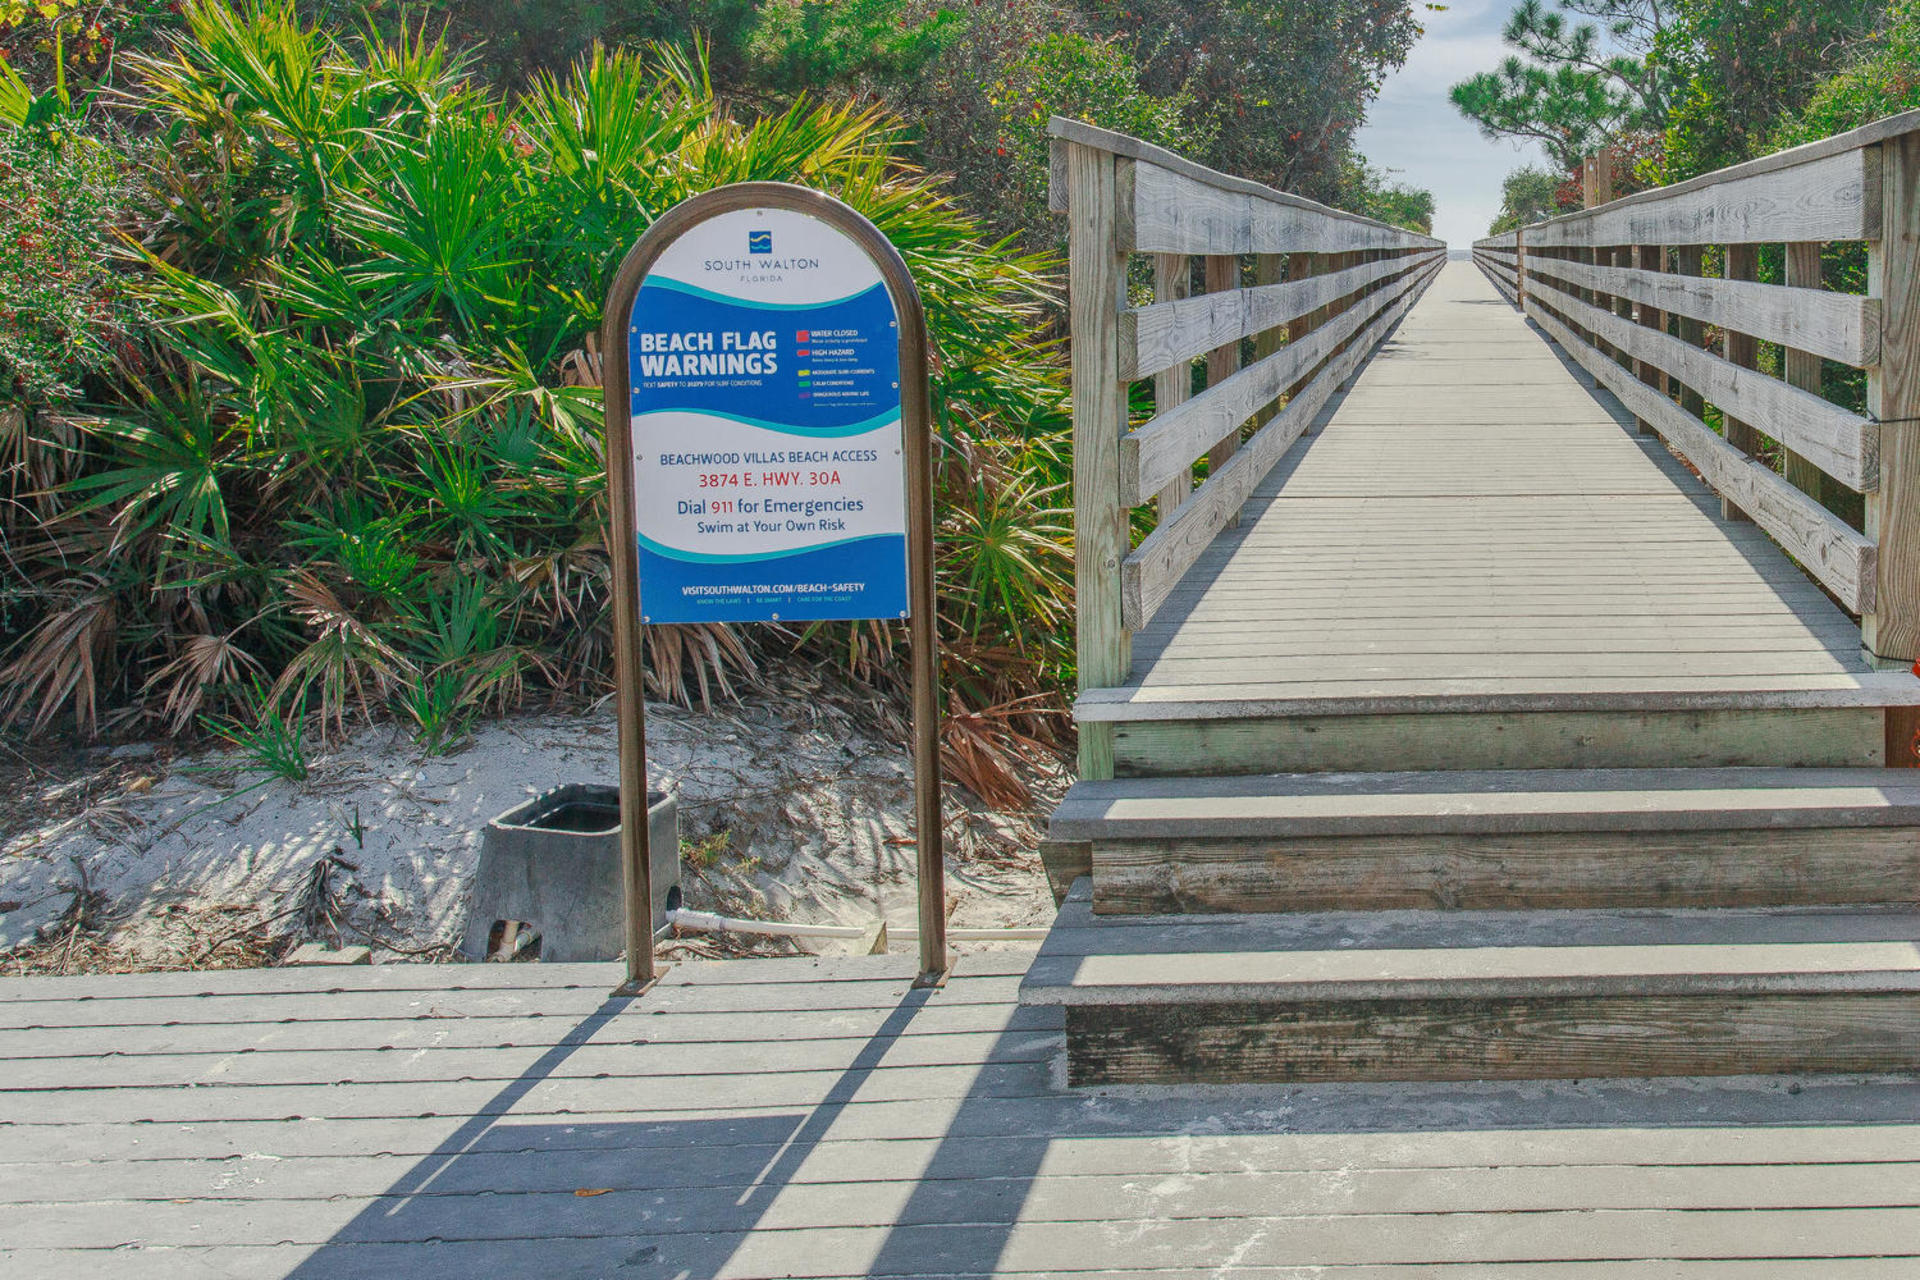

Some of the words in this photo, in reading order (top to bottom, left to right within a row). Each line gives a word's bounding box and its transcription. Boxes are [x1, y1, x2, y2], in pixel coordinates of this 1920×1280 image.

[704, 260, 751, 271] SOUTH
[759, 258, 819, 270] WALTON
[640, 332, 714, 352] BEACH
[722, 331, 777, 351] FLAG
[640, 352, 778, 377] WARNINGS
[660, 453, 740, 465] BEACHWOOD
[743, 452, 785, 464] VILLAS
[788, 450, 829, 463] BEACH
[832, 449, 878, 462] ACCESS
[699, 474, 738, 488] 3874
[743, 473, 757, 487] E.
[762, 471, 804, 486] HWY.
[809, 470, 841, 485] 30A
[677, 500, 706, 514] Dial
[711, 501, 733, 513] 911
[738, 498, 759, 513] for
[764, 496, 864, 516] Emergencies
[697, 519, 733, 533] Swim
[737, 520, 750, 532] at
[753, 520, 782, 533] Your
[785, 519, 816, 531] Own
[819, 517, 846, 531] Risk
[681, 582, 866, 596] VISITSOUTHWALTON.COM/BEACH-SAFETY
